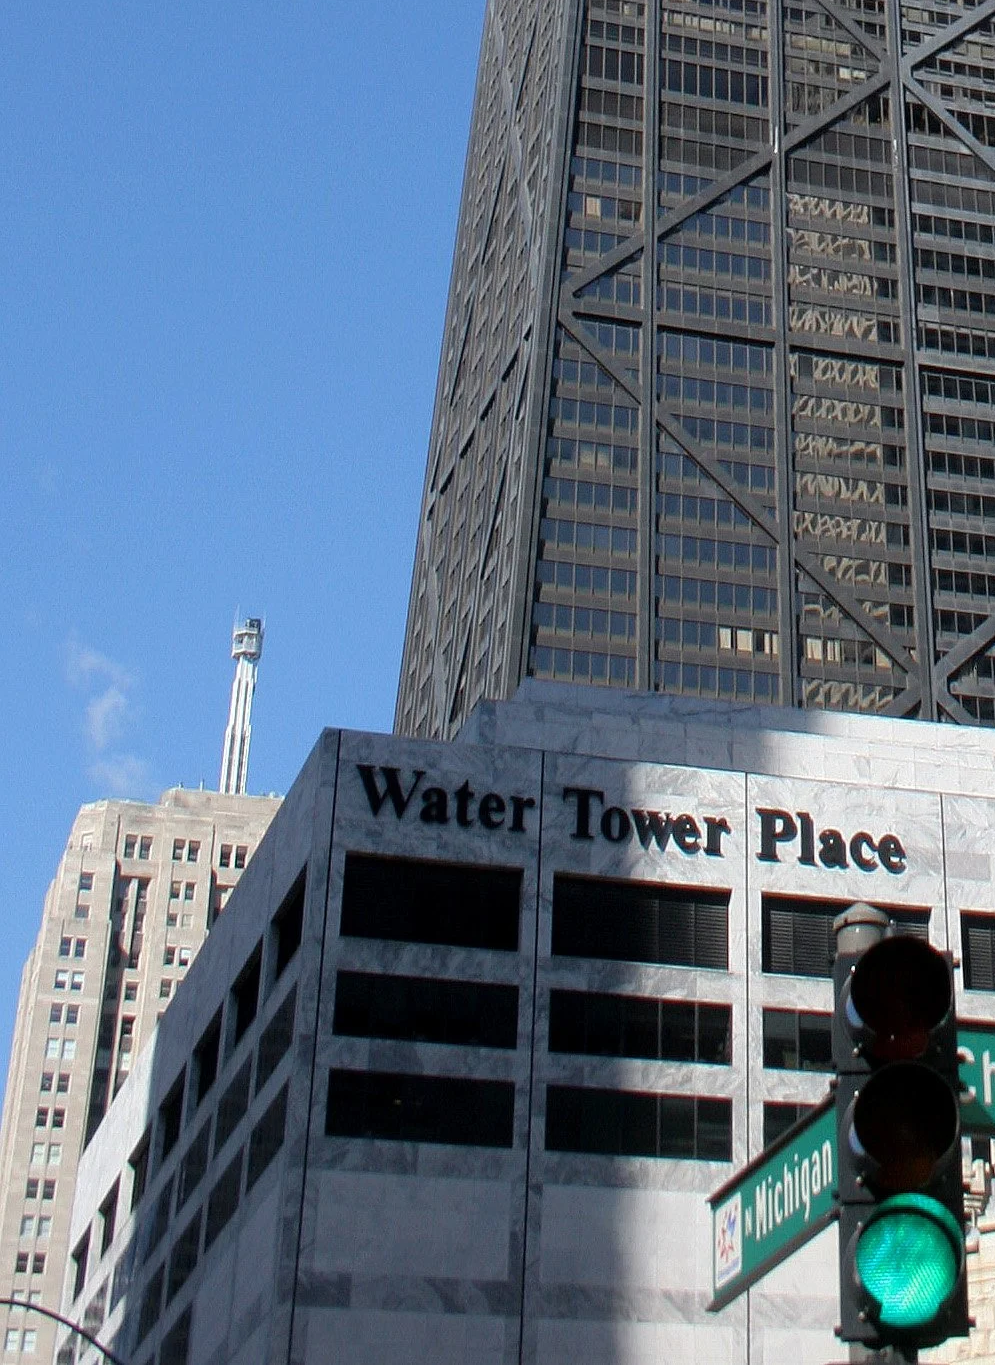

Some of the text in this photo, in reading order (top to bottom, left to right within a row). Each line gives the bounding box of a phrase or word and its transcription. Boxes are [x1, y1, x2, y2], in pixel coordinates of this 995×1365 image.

[355, 764, 908, 875] Water Tower Place
[755, 1139, 833, 1242] Michigan
